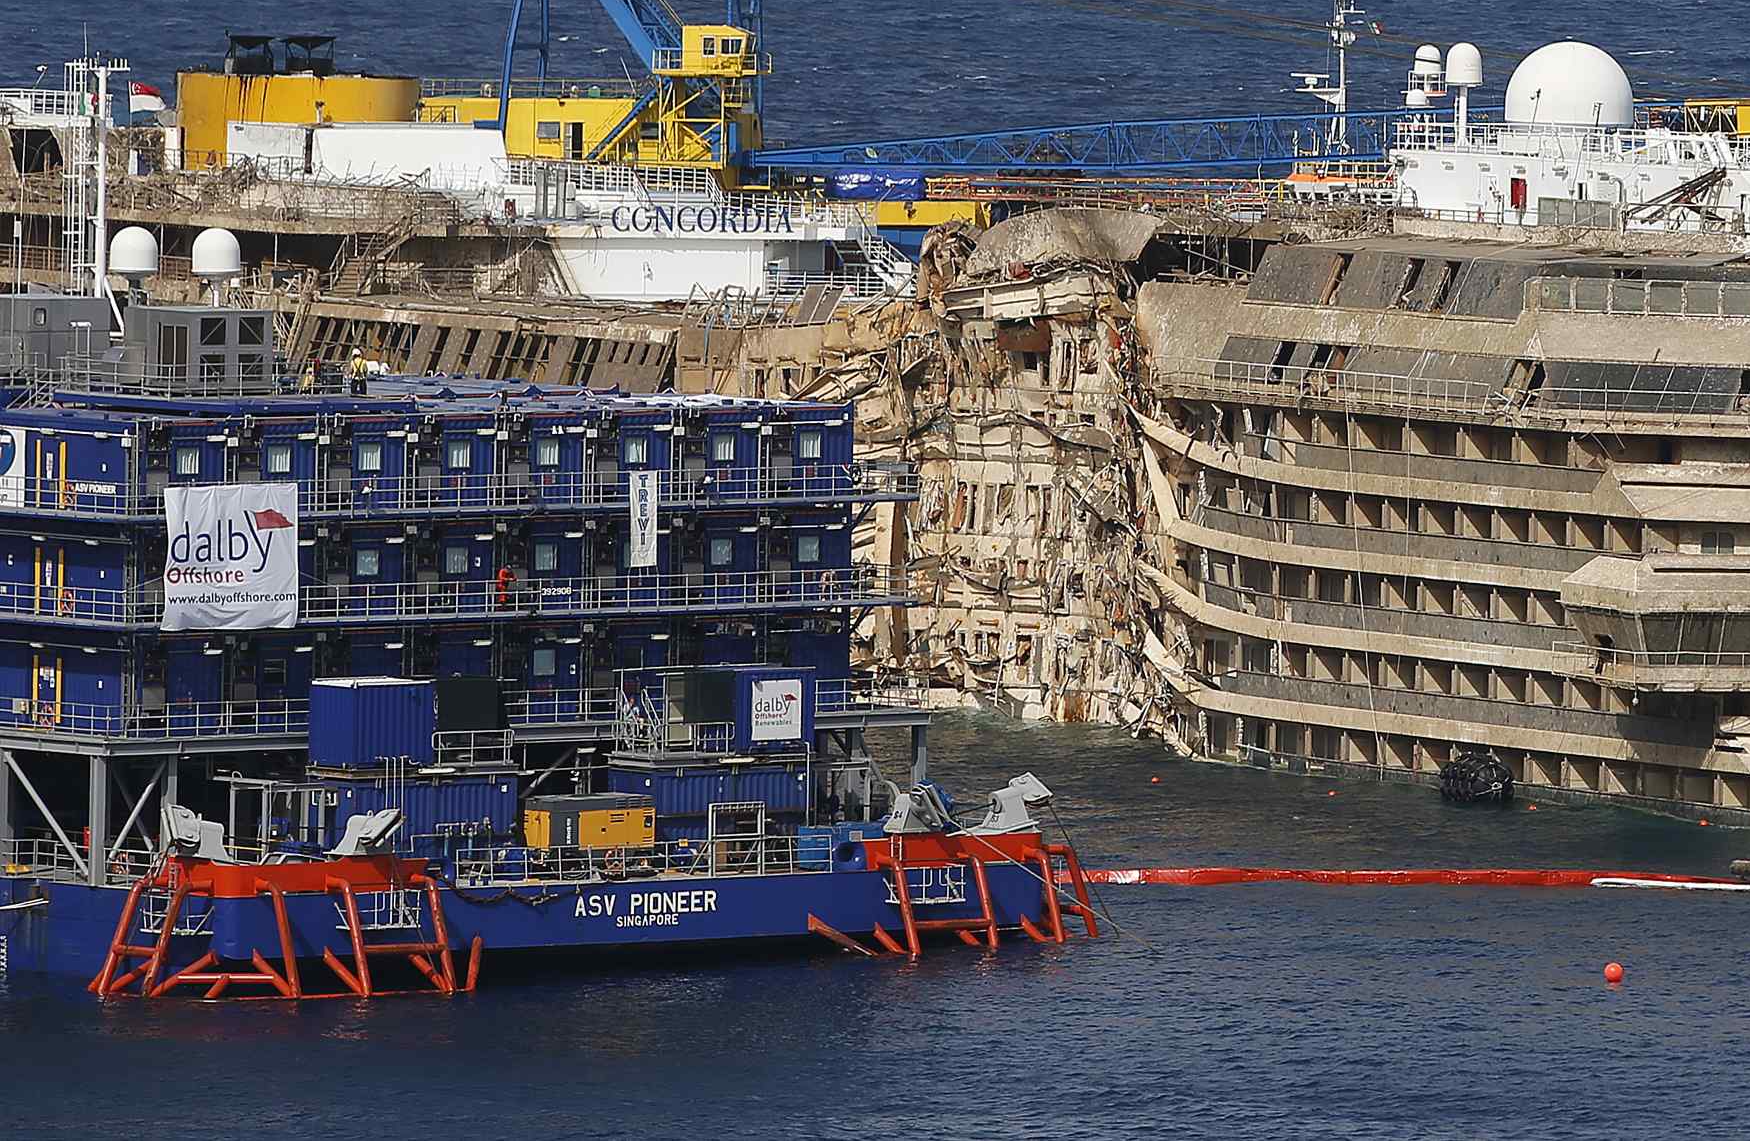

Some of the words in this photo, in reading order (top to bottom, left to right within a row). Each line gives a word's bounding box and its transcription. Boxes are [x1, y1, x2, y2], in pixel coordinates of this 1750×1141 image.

[611, 205, 794, 234] CONCORDIA
[75, 483, 88, 492] ASV
[88, 483, 117, 494] PIONEER
[638, 474, 650, 546] TREVI
[171, 510, 273, 573] dalby
[167, 567, 244, 584] Offshore
[168, 592, 297, 606] www.dalbyoffshore.com
[754, 694, 791, 716] dalby
[574, 894, 616, 917] ASV
[629, 890, 717, 915] PIONEER
[616, 913, 679, 928] SINGAPORE
